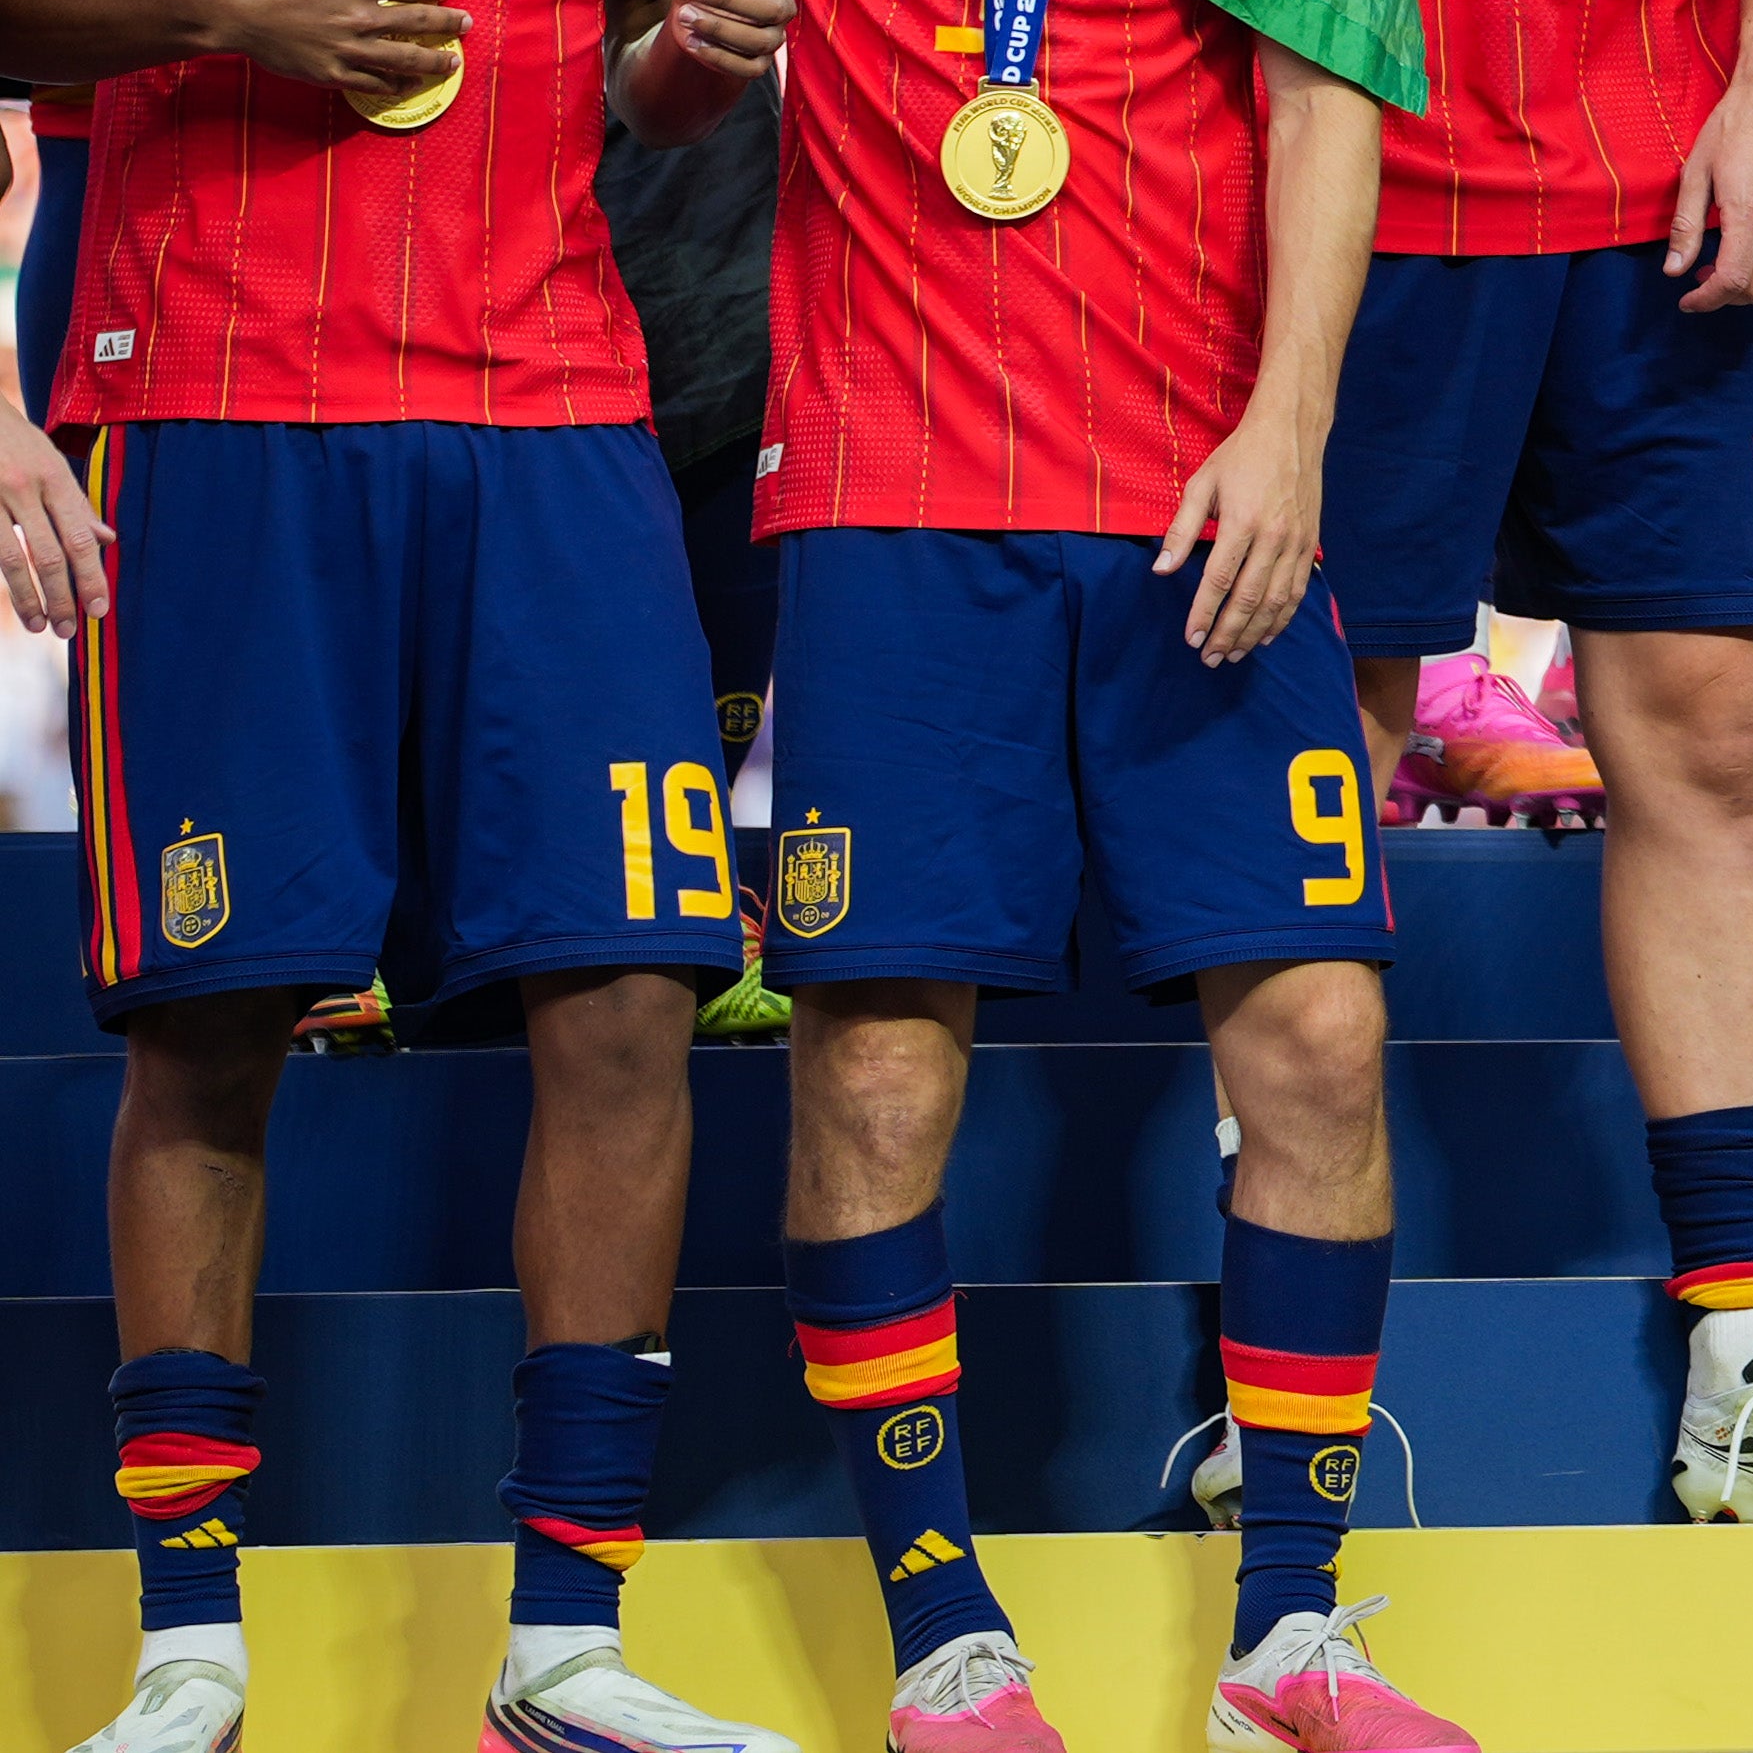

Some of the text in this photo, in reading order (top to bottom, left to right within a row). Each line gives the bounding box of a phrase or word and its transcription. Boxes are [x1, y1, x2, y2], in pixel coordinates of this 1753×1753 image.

[1006, 15, 1032, 63] CUP
[970, 97, 1008, 114] WORLD
[955, 183, 1052, 215] WORLD CHAMPION
[727, 704, 754, 717] RF
[727, 719, 754, 731] EF
[1287, 748, 1365, 906] 9
[609, 760, 734, 921] 19
[894, 1418, 932, 1441] RF
[895, 1434, 932, 1459] EF
[1325, 1458, 1354, 1472] RF
[1325, 1473, 1352, 1489] EF
